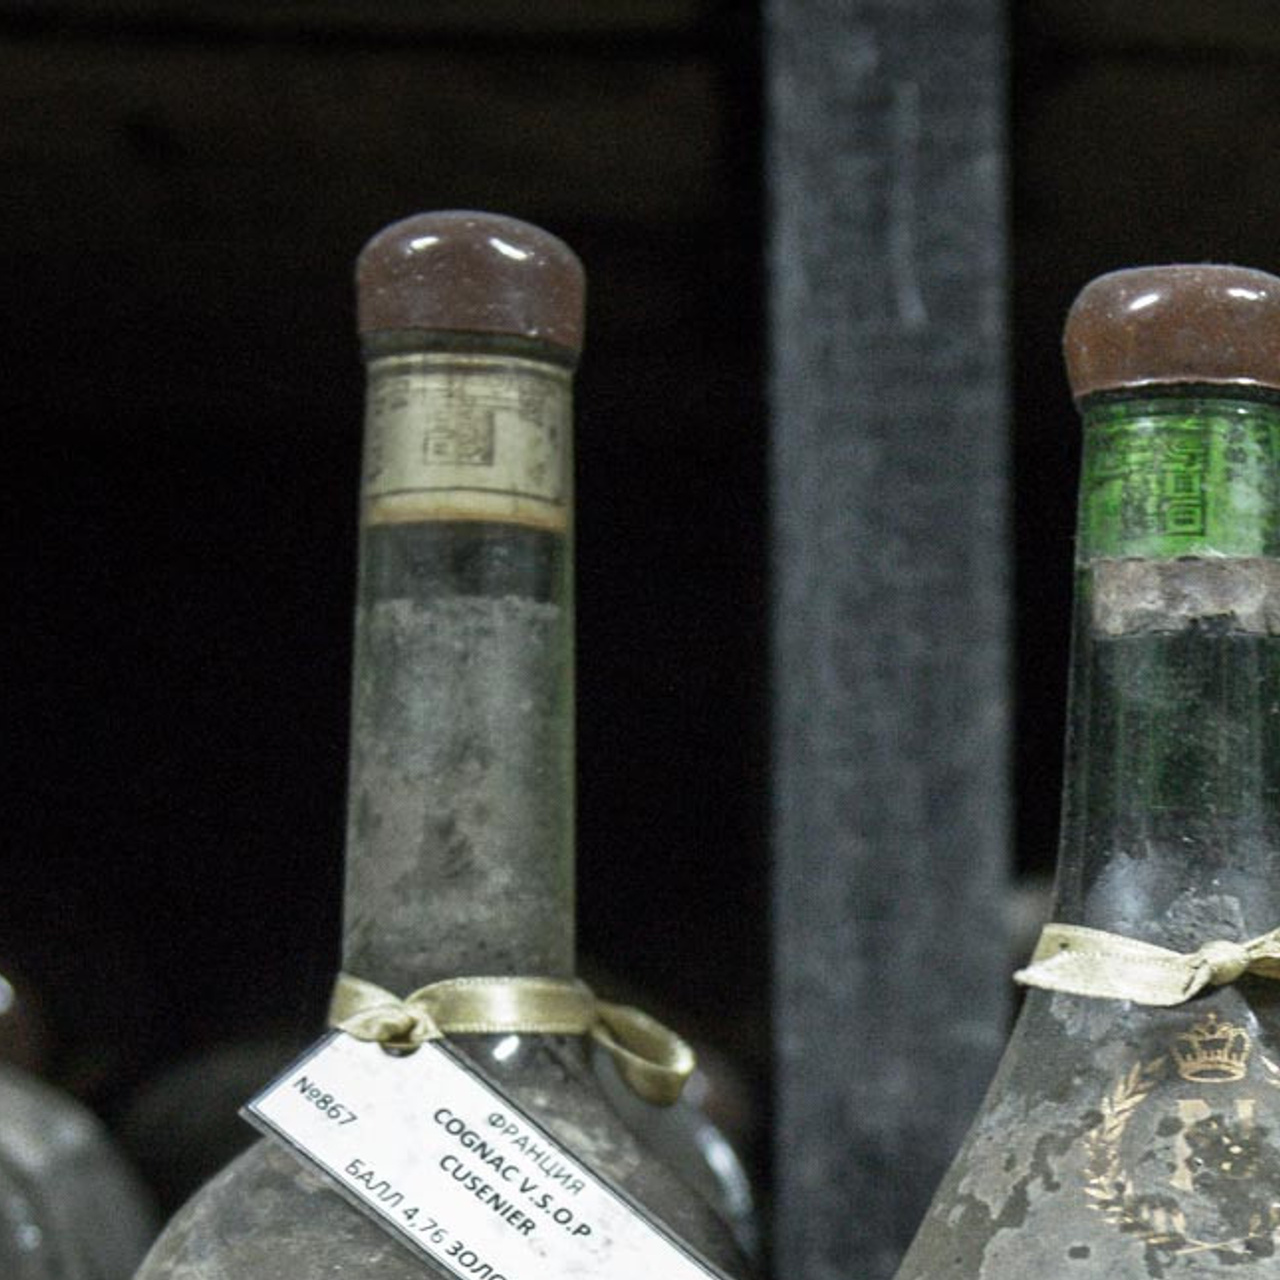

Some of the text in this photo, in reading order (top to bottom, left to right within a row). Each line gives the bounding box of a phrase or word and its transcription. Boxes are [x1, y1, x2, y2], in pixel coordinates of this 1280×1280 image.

[292, 1075, 359, 1127] №867
[433, 1107, 592, 1237] COGNAC V.S.O.P
[438, 1154, 537, 1237] CUSENIER
[487, 1112, 587, 1196] ФРАНЦИЯ
[343, 1158, 405, 1209] БАЛЛ
[403, 1207, 449, 1245] 4,76
